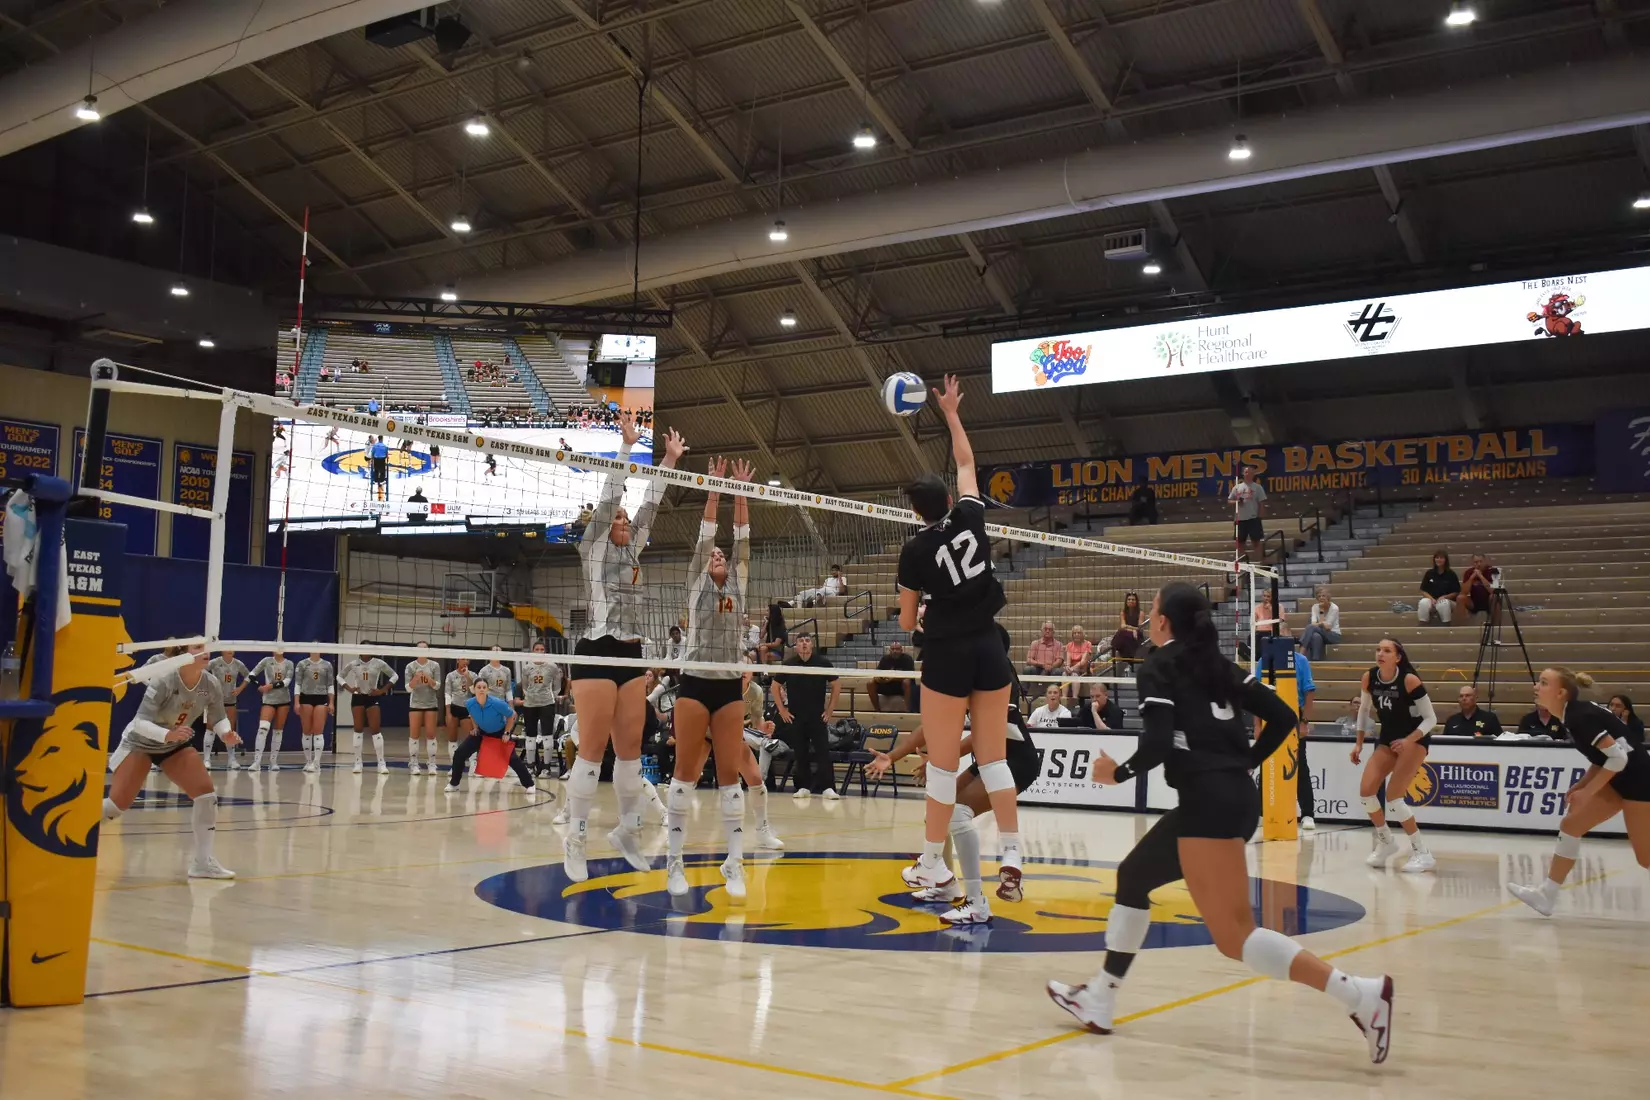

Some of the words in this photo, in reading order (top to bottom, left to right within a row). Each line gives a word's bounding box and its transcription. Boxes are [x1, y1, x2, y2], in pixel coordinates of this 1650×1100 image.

[1568, 276, 1587, 284] NEST
[1198, 325, 1229, 338] Hunt
[1198, 333, 1252, 352] Regional
[1053, 340, 1085, 361] Too
[1199, 349, 1267, 364] Healthcare
[307, 407, 328, 418] EAST
[332, 412, 359, 424] TEXAS
[361, 418, 379, 428] A&M
[4, 426, 39, 437] MEN'S
[8, 434, 35, 443] GOLF
[403, 425, 424, 436] EAST
[426, 429, 450, 440] TEXAS
[453, 434, 469, 444] A&M
[0, 444, 52, 454] OURNAMENT
[112, 440, 144, 450] MEN'S
[114, 448, 140, 456] GOLF
[490, 440, 509, 450] EAST
[511, 445, 533, 455] TEXAS
[536, 449, 550, 458] A&M
[14, 453, 50, 468] 2022
[570, 454, 587, 463] EAST
[589, 458, 609, 468] TEXAS
[611, 461, 624, 470] A&M
[1051, 459, 1132, 488] LION
[1147, 449, 1267, 480] MEN'S
[1282, 430, 1558, 472] BASKETBALL
[180, 466, 200, 475] NCAA
[642, 467, 658, 476] EAST
[660, 470, 678, 480] TEXAS
[1402, 468, 1420, 485] 30
[1425, 460, 1546, 484] ALL-AMERICANS
[181, 475, 210, 488] 2019
[708, 479, 722, 487] EAST
[725, 481, 741, 491] TEXAS
[180, 488, 209, 501] 2021
[784, 491, 800, 500] TEXAS
[74, 550, 100, 561] EAST
[935, 530, 985, 586] 12
[69, 563, 102, 574] TEXAS
[632, 567, 639, 585] 7
[67, 576, 103, 592] A&M
[718, 597, 733, 613] 14
[274, 672, 282, 680] 15
[313, 672, 319, 680] 3
[1378, 696, 1392, 710] 14
[1440, 765, 1494, 782] Hilton
[1504, 766, 1564, 790] BEST
[1506, 791, 1534, 814] TO
[1540, 792, 1566, 816] ST
